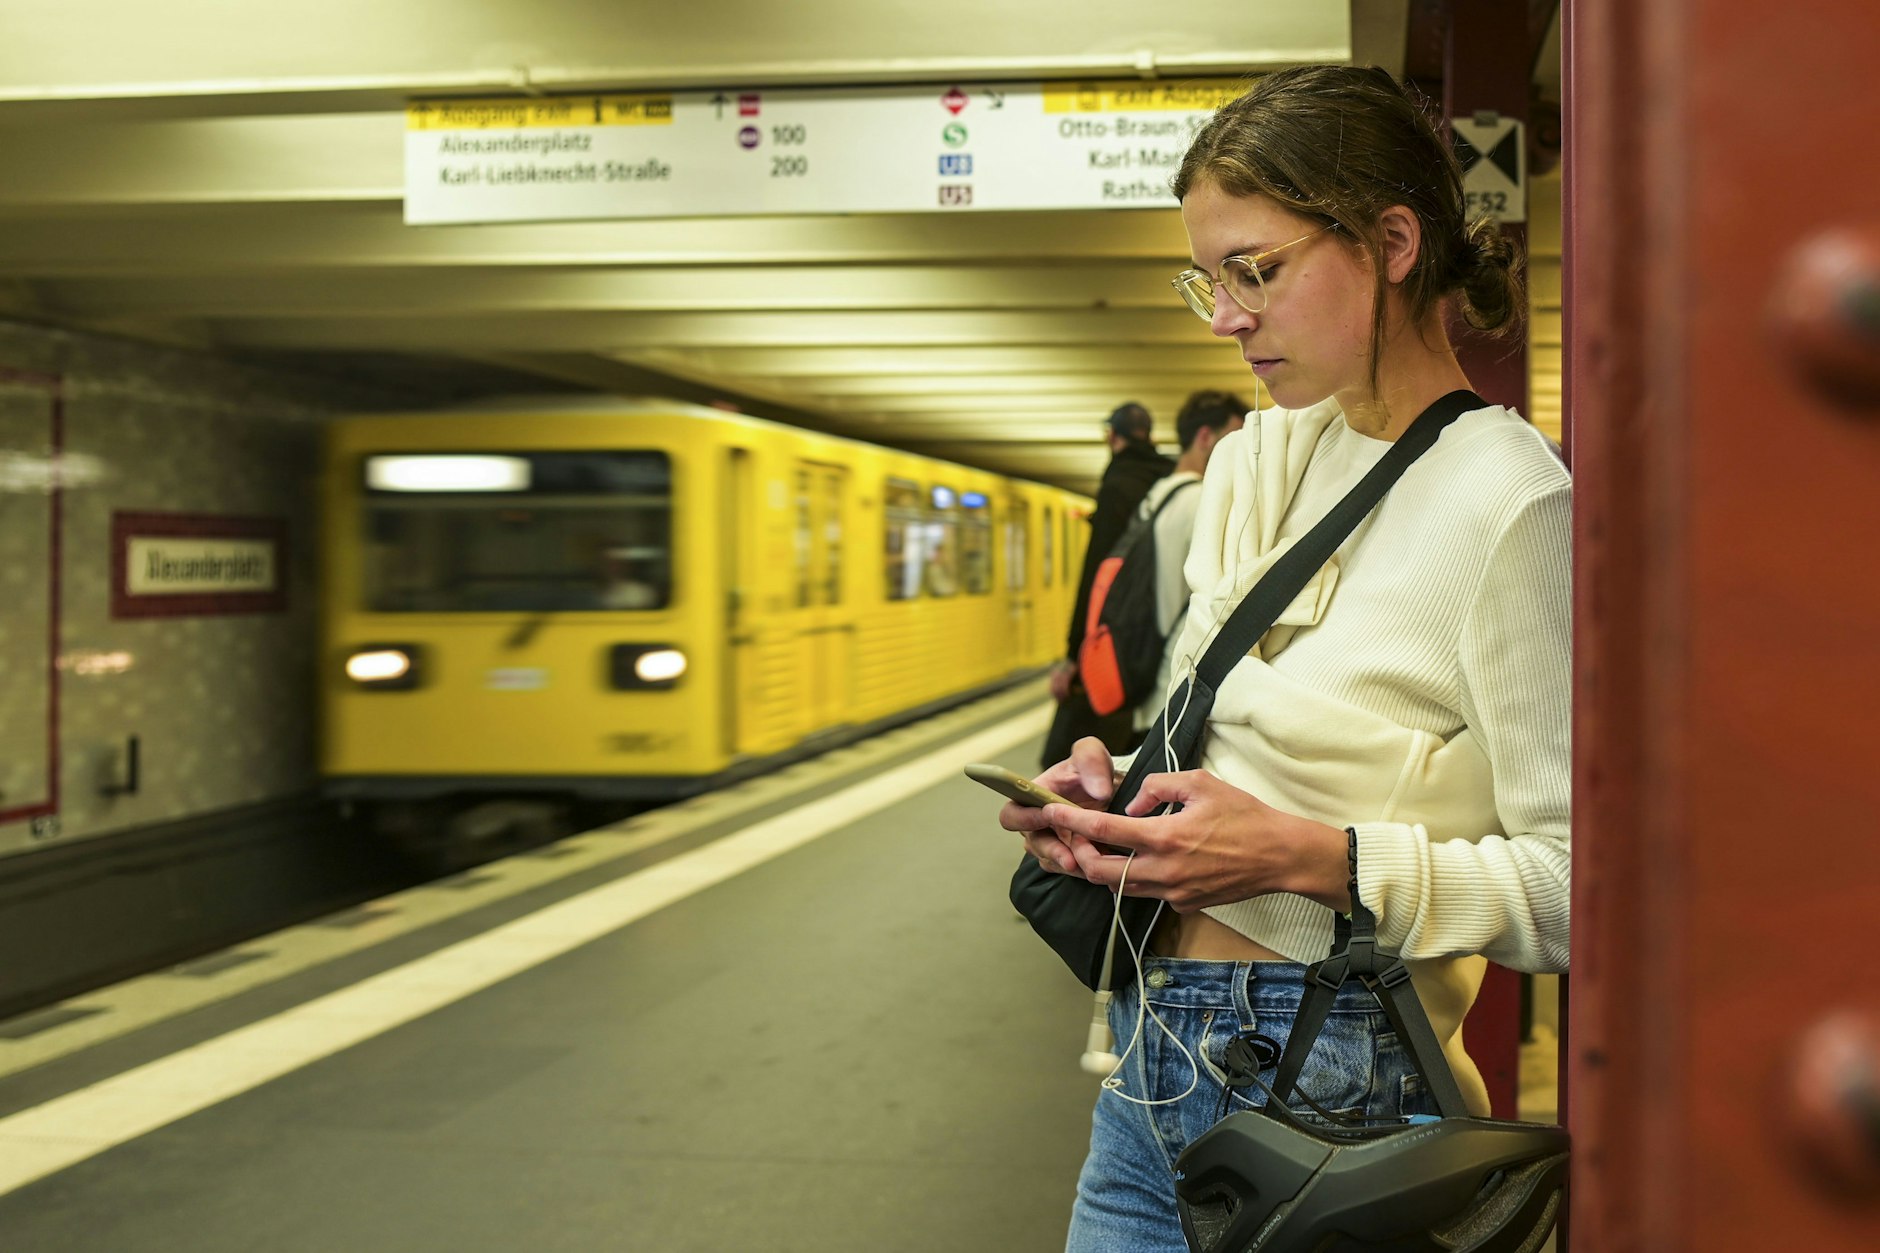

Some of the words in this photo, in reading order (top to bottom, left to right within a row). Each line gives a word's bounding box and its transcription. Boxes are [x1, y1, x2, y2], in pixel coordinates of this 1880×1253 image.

[440, 102, 526, 128] Ausgang
[440, 132, 592, 157] Alexanderplatz
[772, 124, 806, 146] 100
[440, 159, 671, 185] Karl-Liebknecht-Straße
[771, 155, 808, 177] 200
[146, 550, 262, 583] Alexanderplatz
